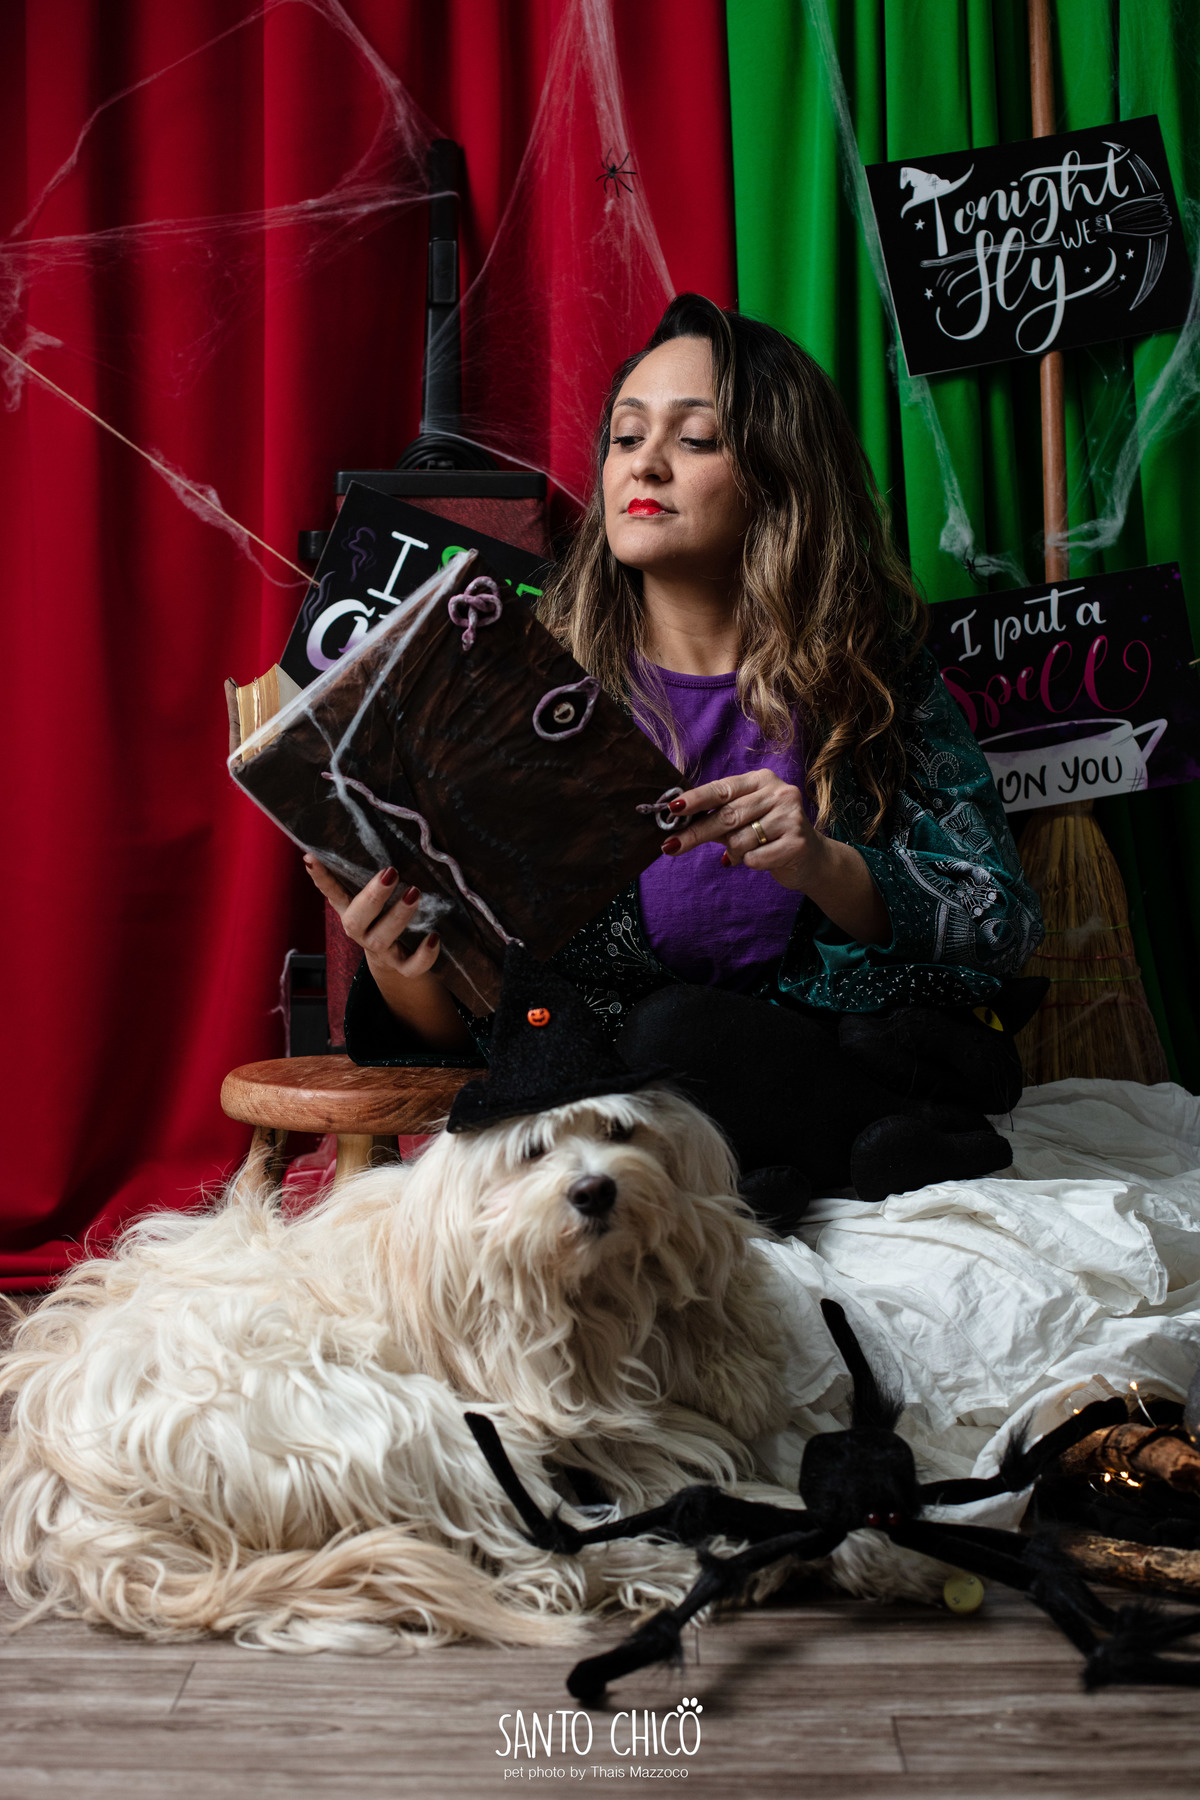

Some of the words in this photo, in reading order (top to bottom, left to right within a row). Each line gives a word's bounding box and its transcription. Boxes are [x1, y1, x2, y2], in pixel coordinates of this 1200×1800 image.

[900, 147, 1130, 256] Tonight
[1060, 219, 1097, 248] WE
[951, 609, 982, 661] I
[994, 586, 1085, 660] put
[1075, 601, 1106, 625] a
[998, 765, 1047, 803] ON
[1058, 755, 1122, 793] YOU
